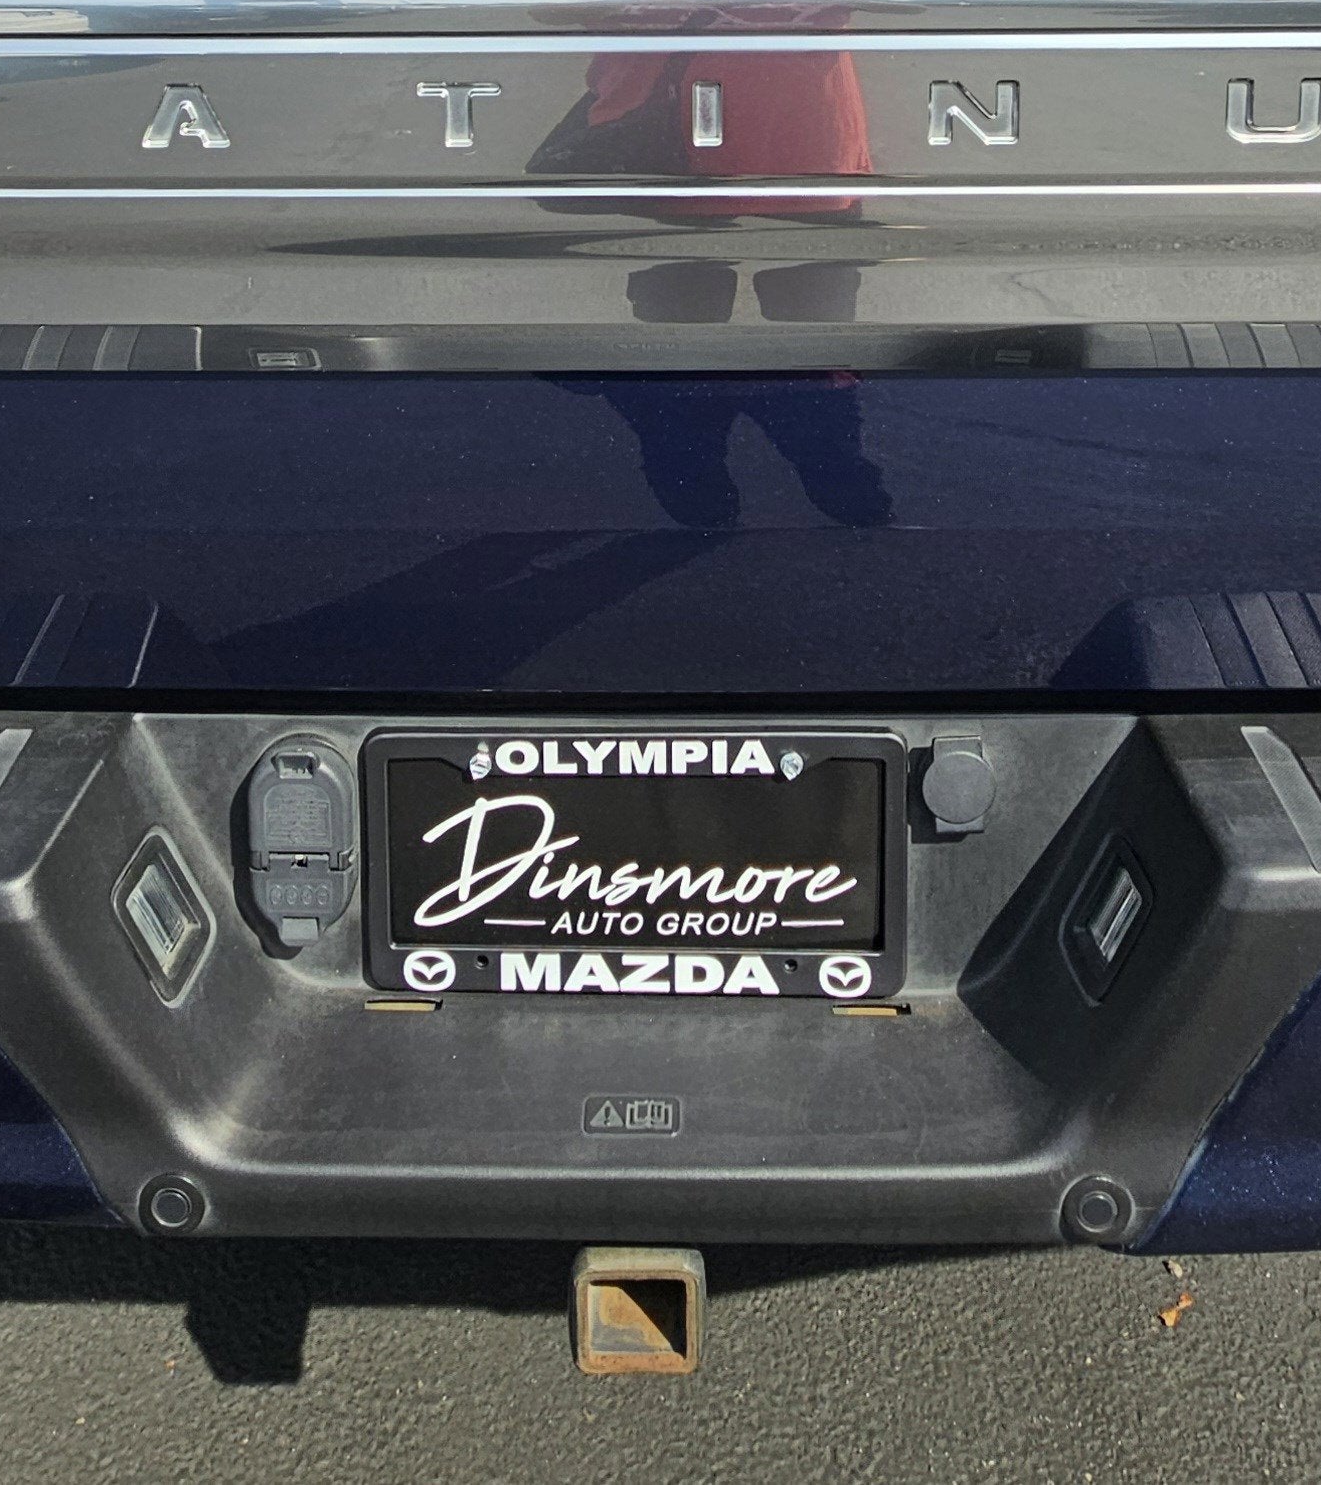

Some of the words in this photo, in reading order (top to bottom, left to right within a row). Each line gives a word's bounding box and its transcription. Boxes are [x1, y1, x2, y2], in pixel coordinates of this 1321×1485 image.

[495, 740, 776, 776] OLYMPIA
[413, 795, 858, 927] Dinsmore
[551, 912, 645, 936] AUTO
[656, 912, 778, 936] GROUP
[499, 954, 780, 995] MAZDA
